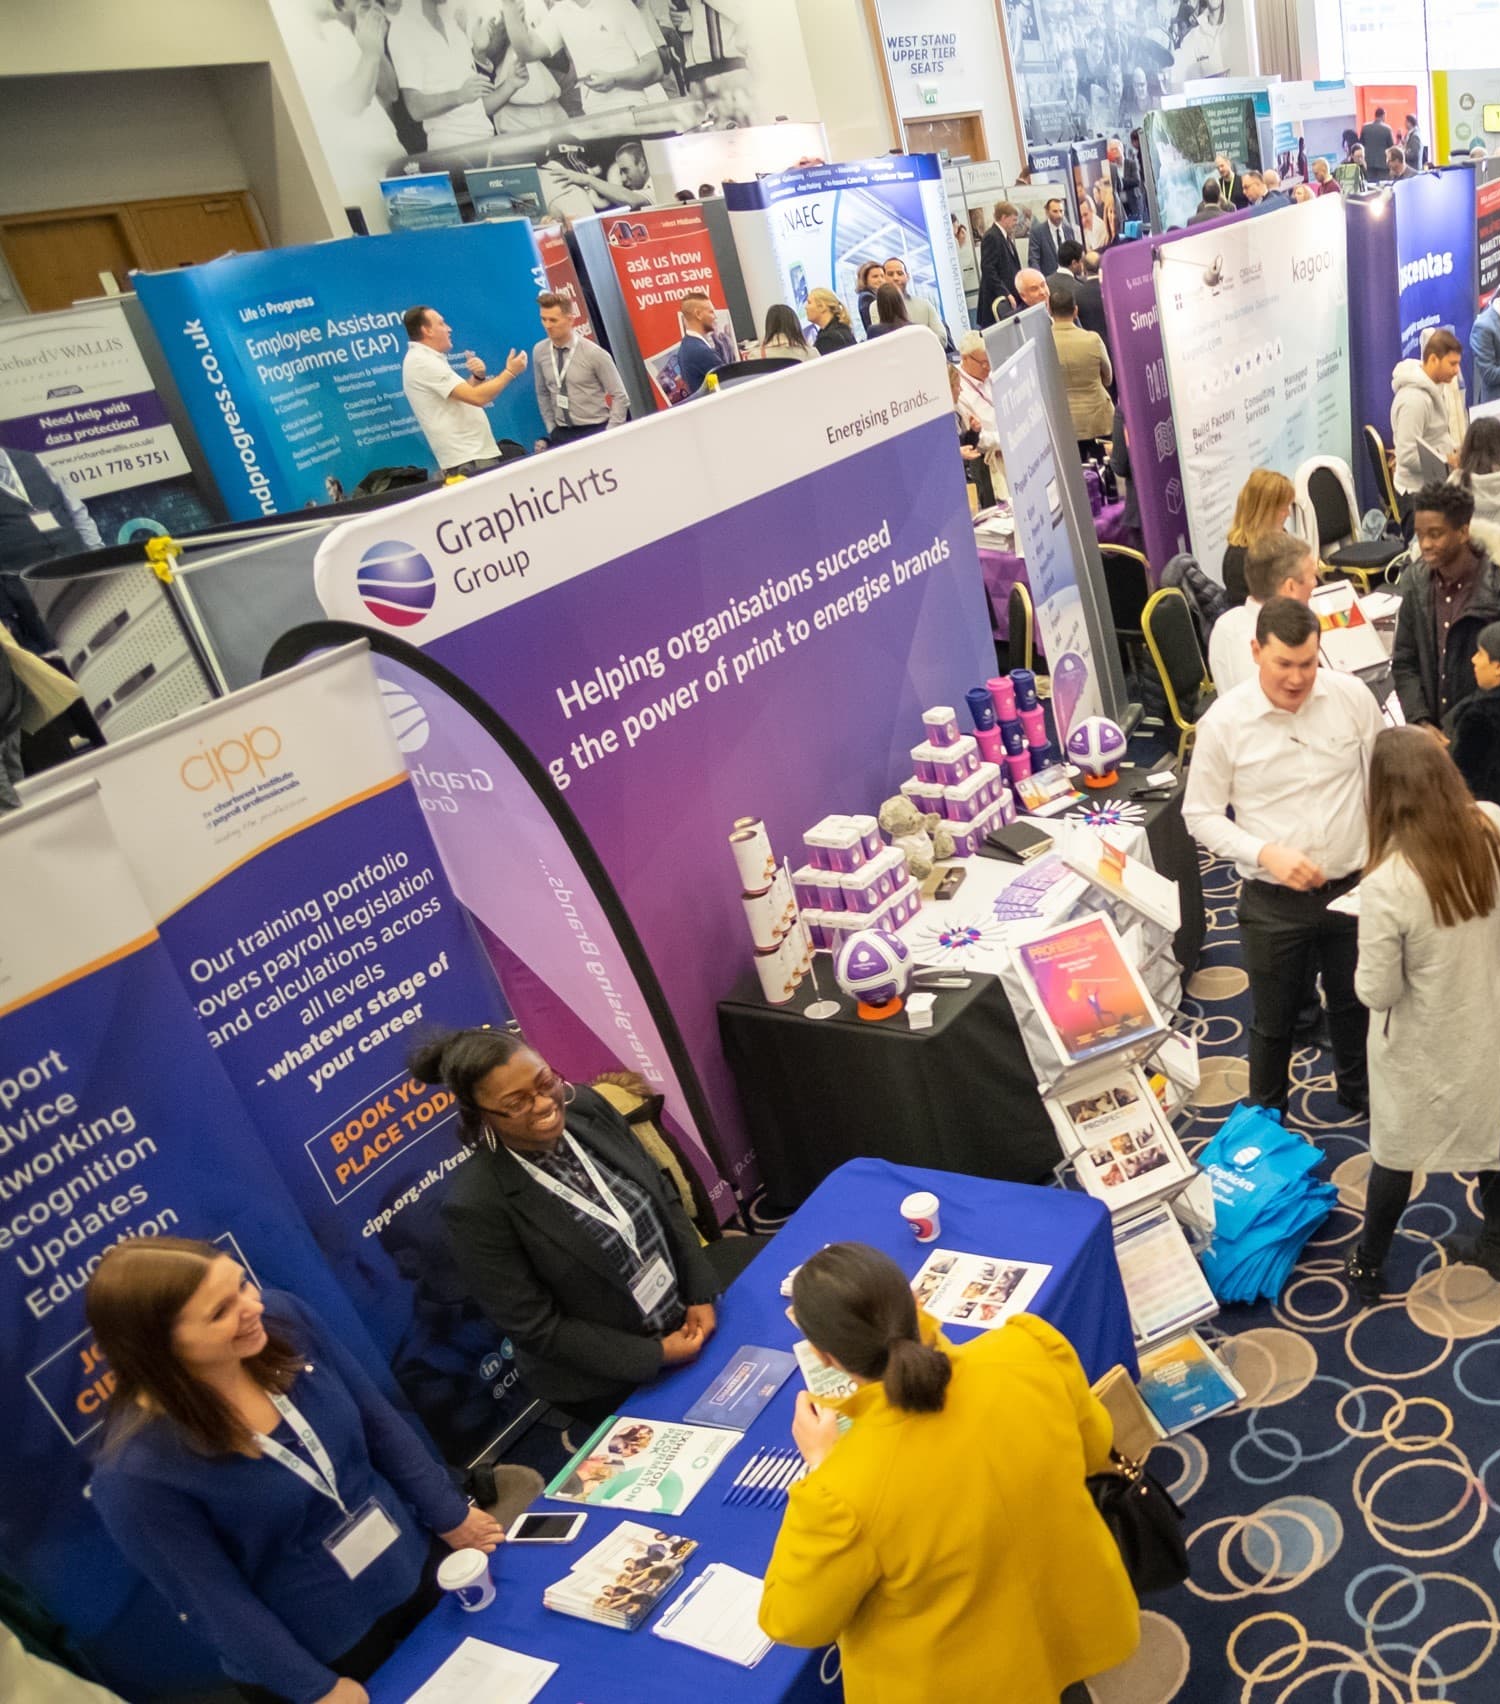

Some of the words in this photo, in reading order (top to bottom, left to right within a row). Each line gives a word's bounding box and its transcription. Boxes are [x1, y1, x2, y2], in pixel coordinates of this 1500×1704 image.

[887, 34, 919, 49] WEST
[921, 33, 957, 47] STAND
[892, 48, 929, 62] UPPER
[931, 47, 956, 59] TIER
[910, 61, 944, 75] SEATS
[1033, 155, 1060, 169] VISTAGE
[783, 203, 824, 232] NAEC
[626, 255, 651, 273] ask
[653, 255, 669, 269] us
[671, 251, 701, 266] how
[631, 277, 653, 291] we
[655, 271, 679, 288] can
[681, 267, 712, 283] save
[239, 309, 259, 324] Life
[266, 296, 315, 317] Progress
[636, 291, 663, 310] you
[0, 351, 49, 374] ichard
[61, 336, 125, 361] WALLIS
[246, 327, 322, 361] Employee
[257, 346, 349, 385] Programme
[351, 332, 400, 361] (EAP)
[39, 413, 74, 429] Need
[75, 409, 102, 423] help
[104, 401, 131, 415] with
[1244, 384, 1276, 411] Consulting
[1245, 404, 1271, 425] Services
[45, 432, 73, 445] data
[74, 416, 140, 442] protection?
[825, 407, 891, 447] Energising
[1210, 407, 1236, 433] Factory
[1194, 432, 1222, 456] Services
[69, 464, 103, 484] 0121
[106, 459, 134, 475] 778
[136, 450, 170, 468] 5751
[434, 461, 619, 557] GraphicArts
[451, 546, 533, 596] Group
[554, 643, 667, 720] Helping
[666, 563, 814, 663] organisations
[814, 518, 893, 583] succeed
[571, 721, 620, 771] the
[620, 677, 702, 745] power
[703, 658, 732, 693] of
[732, 627, 786, 687] print
[786, 617, 812, 643] to
[812, 572, 892, 632] energise
[891, 533, 951, 591] brands
[180, 725, 282, 793] cipp
[212, 805, 242, 828] payroll
[242, 780, 300, 812] professionals
[213, 786, 257, 814] chartered
[257, 770, 295, 792] institute
[190, 946, 236, 984] Our
[237, 899, 322, 957] training
[322, 850, 410, 912] portfolio
[193, 968, 263, 1020] overs
[262, 921, 335, 984] payroll
[334, 866, 435, 935] legislation
[206, 1007, 253, 1049] and
[254, 935, 379, 1021] calculations
[380, 895, 442, 945] across
[299, 996, 325, 1026] all
[324, 962, 386, 1010] levels
[266, 1006, 365, 1081] whatever
[366, 970, 428, 1016] stage
[428, 950, 450, 979] of
[307, 1044, 357, 1094] your
[357, 1002, 424, 1054] career
[329, 1095, 396, 1154] BOOK
[334, 1122, 405, 1186] PLACE
[15, 1183, 150, 1279] Updates
[647, 1429, 695, 1489] EXHIBITOR
[649, 1426, 677, 1454] PACK
[626, 1427, 685, 1503] INFORMATION
